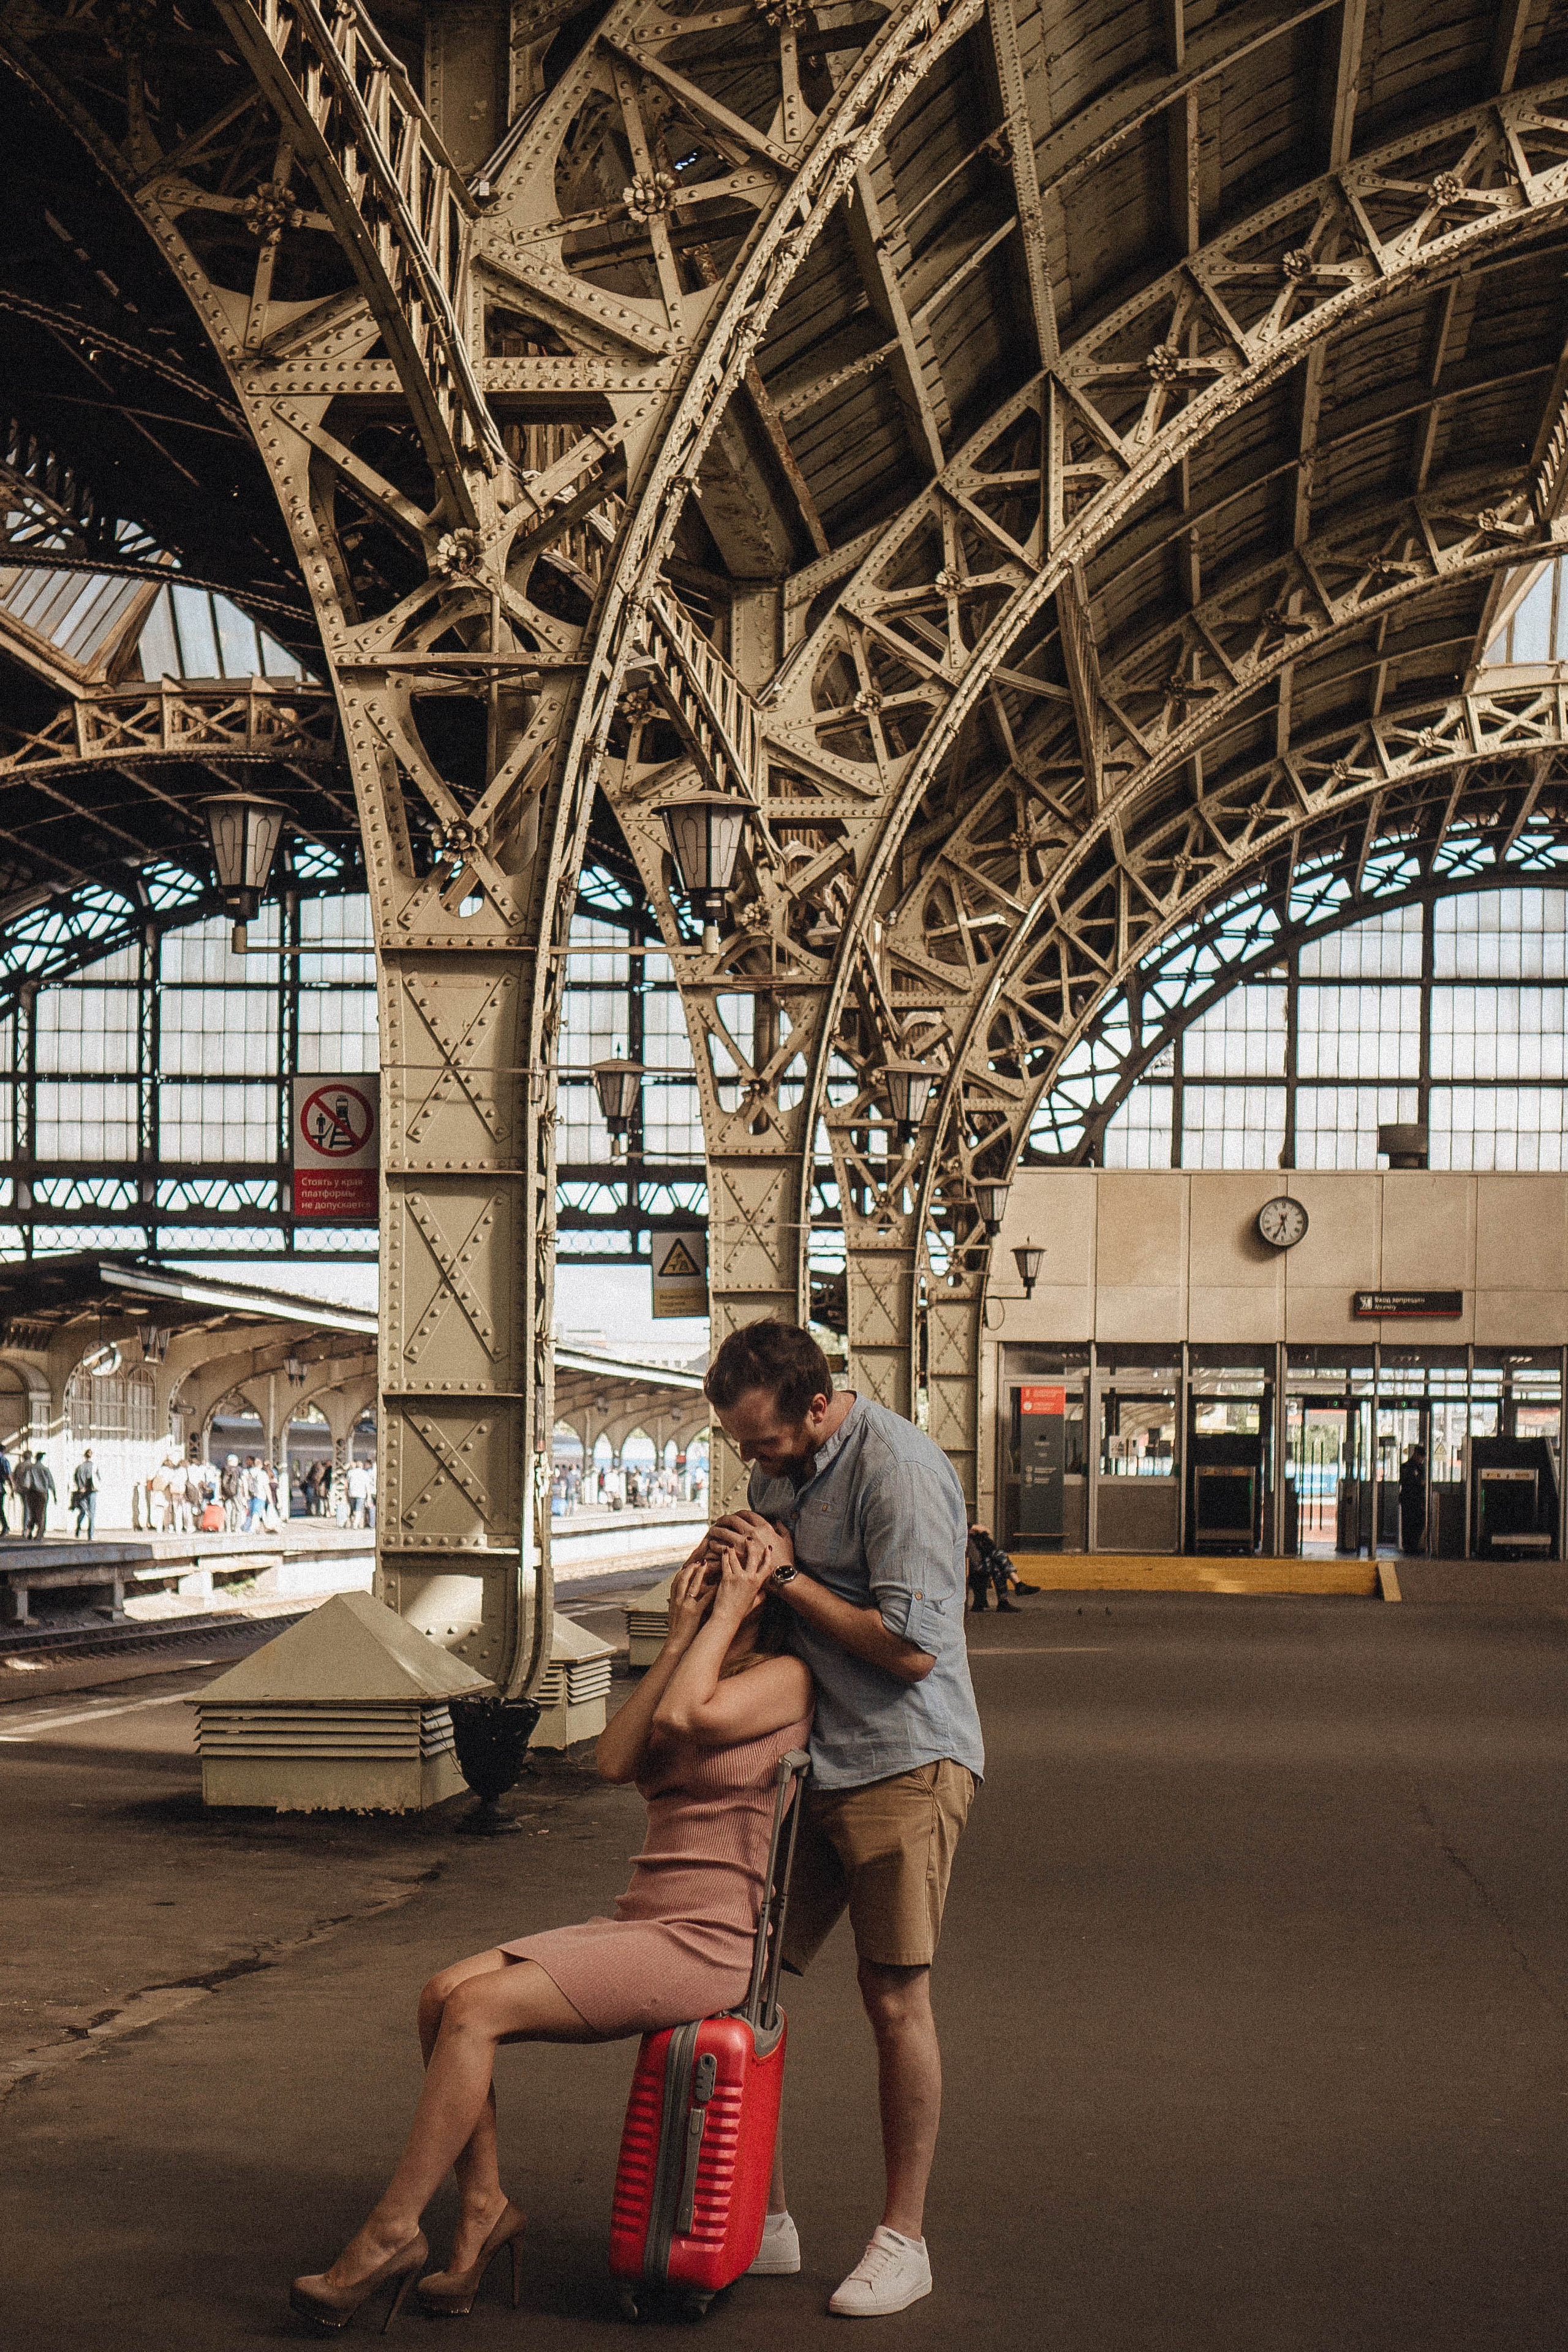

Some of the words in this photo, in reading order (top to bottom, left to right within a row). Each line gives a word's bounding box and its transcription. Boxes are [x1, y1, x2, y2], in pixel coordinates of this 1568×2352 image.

[301, 1177, 332, 1186] Стоять
[334, 1179, 339, 1188] у
[301, 1189, 355, 1199] платформы
